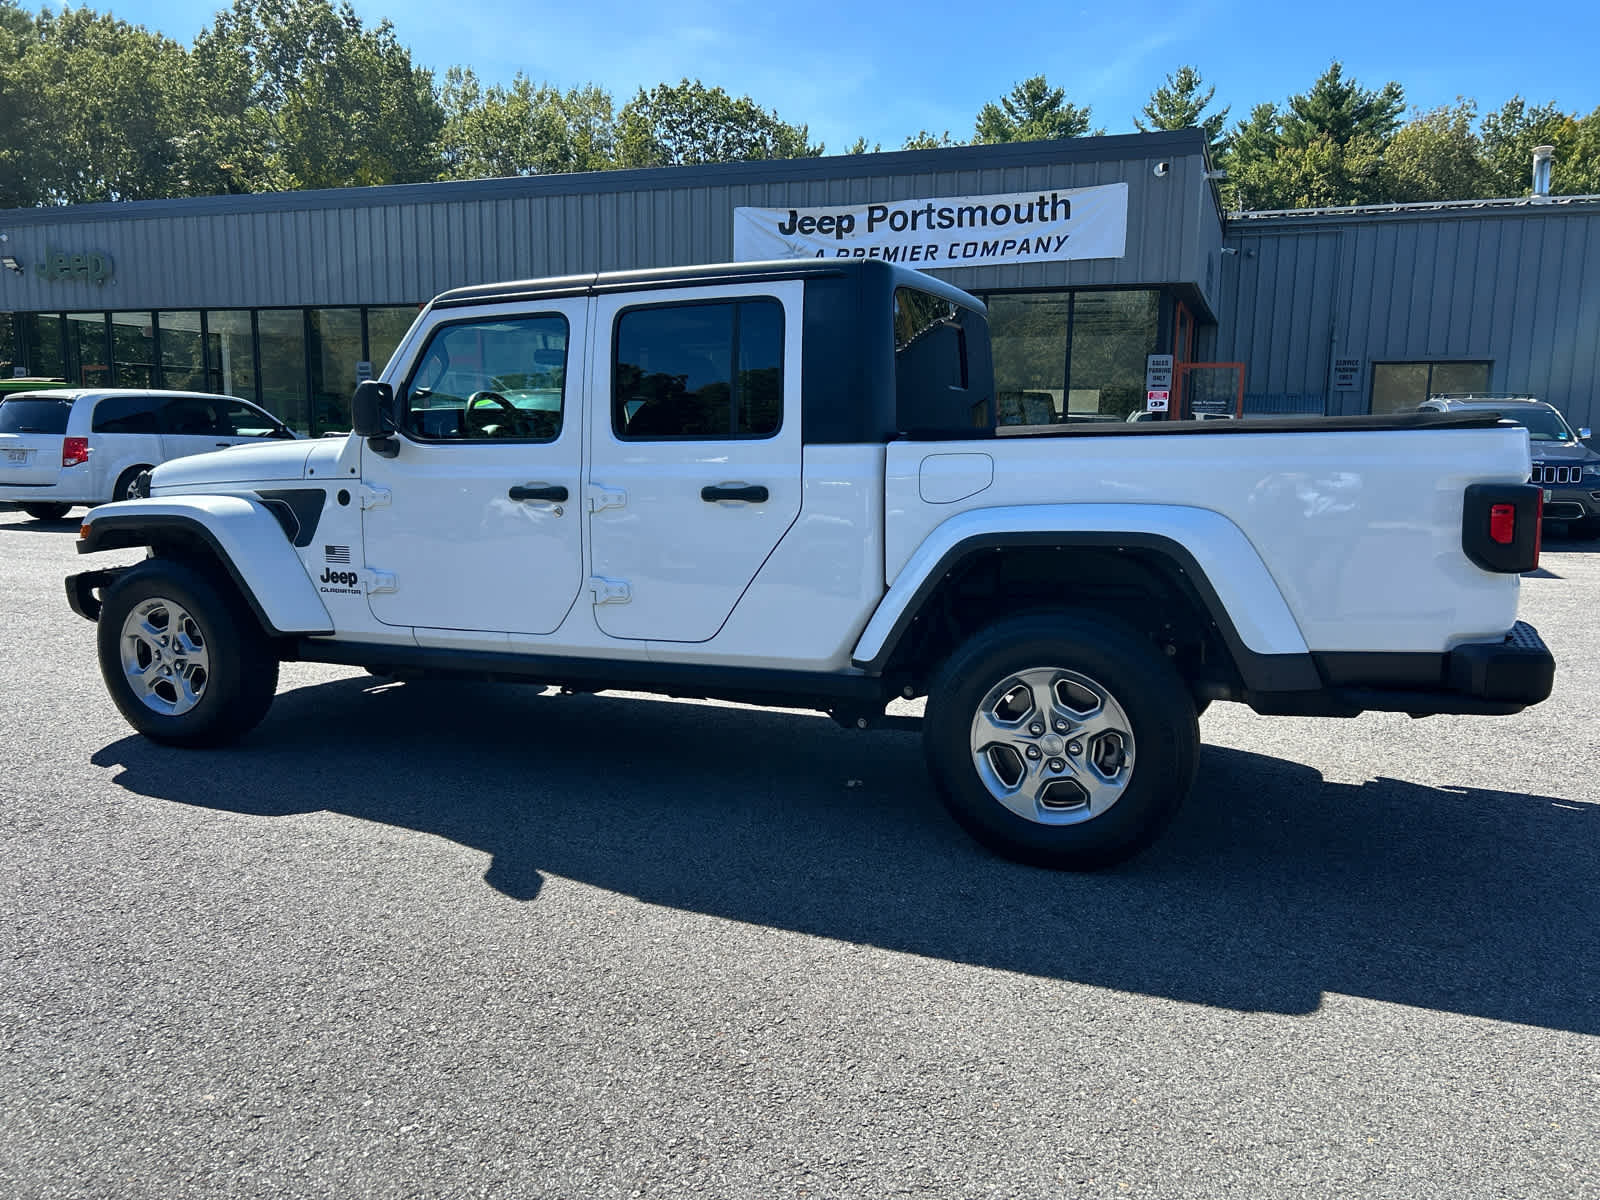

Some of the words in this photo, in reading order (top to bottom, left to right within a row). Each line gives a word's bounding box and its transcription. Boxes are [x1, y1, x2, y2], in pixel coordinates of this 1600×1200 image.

[778, 210, 855, 239] Jeep
[867, 193, 1071, 233] Portsmouth
[836, 244, 939, 263] PREMIER
[948, 235, 1070, 259] COMPANY
[35, 247, 110, 288] Jeep
[320, 567, 358, 587] Jeep
